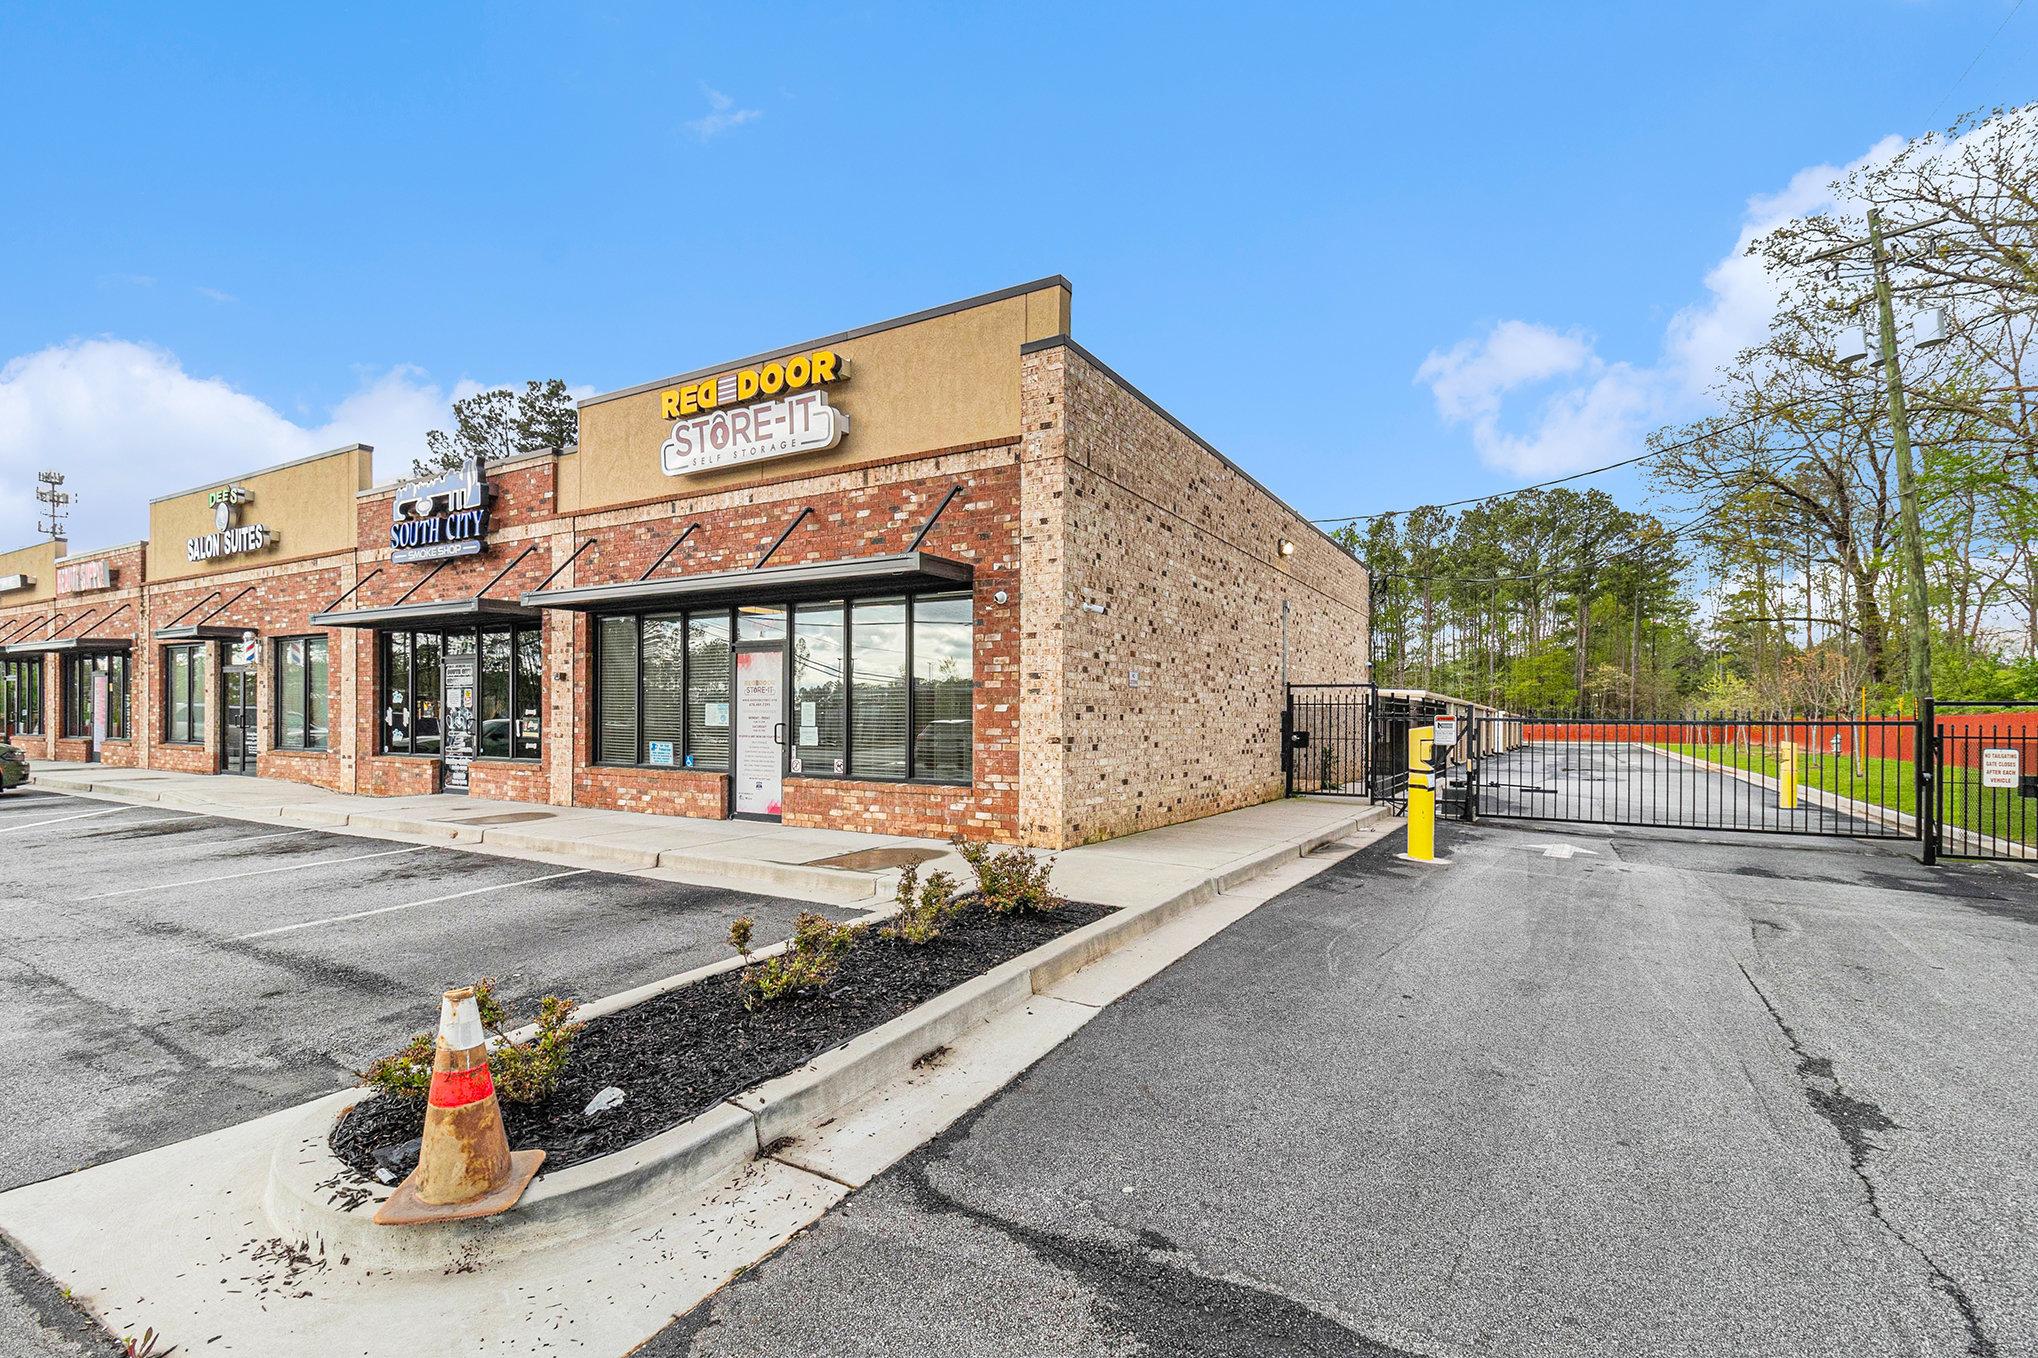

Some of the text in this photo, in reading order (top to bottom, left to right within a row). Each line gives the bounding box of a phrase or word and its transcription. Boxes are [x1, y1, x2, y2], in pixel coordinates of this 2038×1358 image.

[661, 350, 836, 419] RED DOOR
[675, 396, 816, 457] STORE-IT
[692, 438, 797, 466] SELF STORAGE
[187, 524, 264, 562] SALON SUITES
[390, 510, 484, 549] SOUTH CITY
[408, 544, 462, 560] SMOKE SHOP
